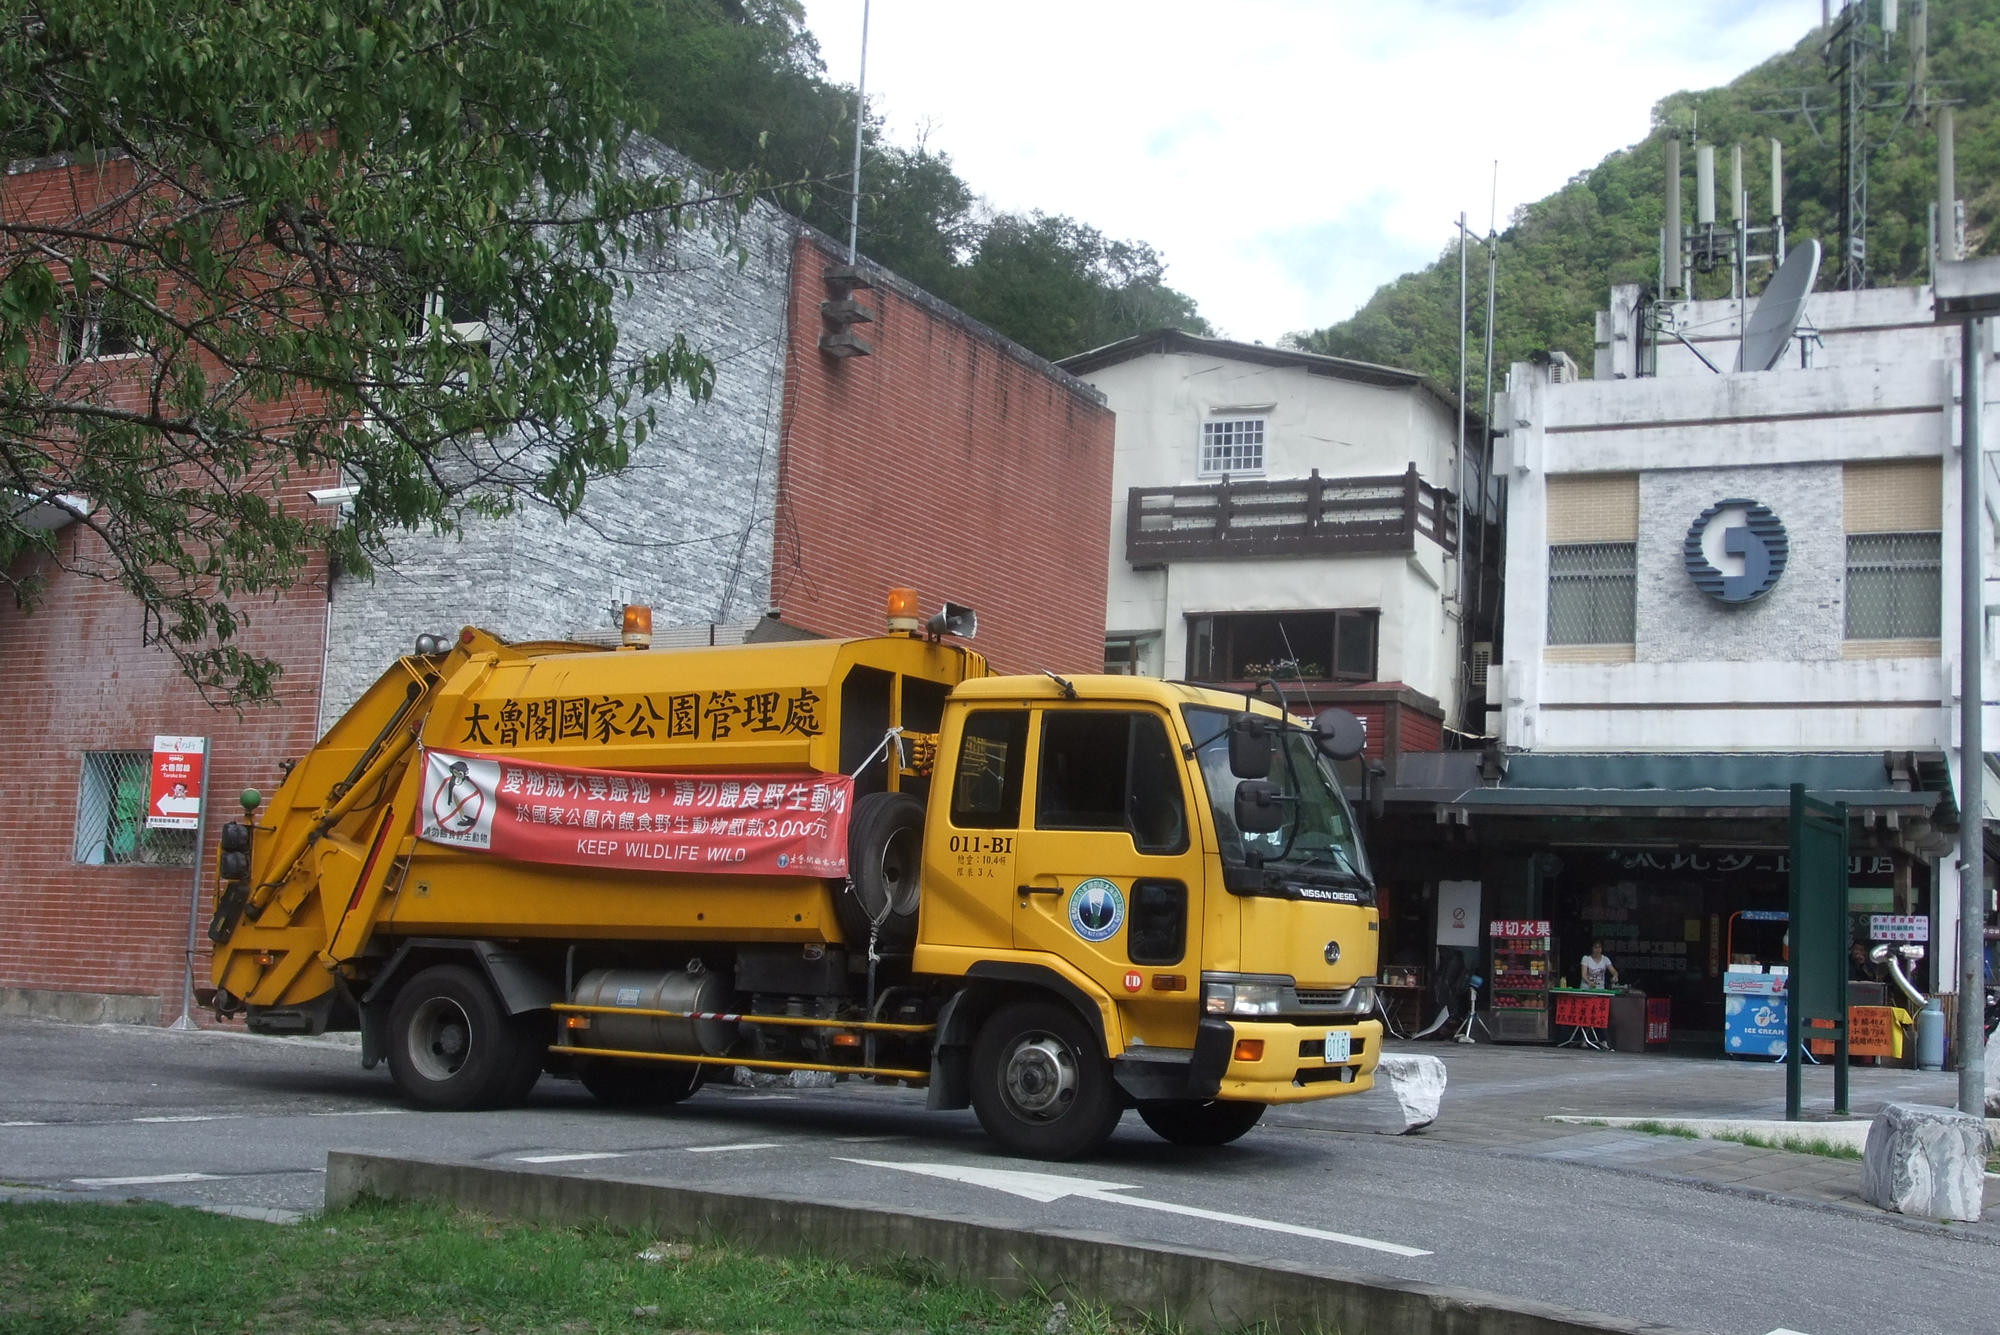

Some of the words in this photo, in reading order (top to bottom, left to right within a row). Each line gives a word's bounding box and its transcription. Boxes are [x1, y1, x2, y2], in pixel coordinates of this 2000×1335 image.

[460, 687, 824, 748] 太魯閣國家公園管理處
[577, 839, 618, 856] KEEP
[625, 841, 700, 861] WILDLIFE
[707, 847, 746, 862] WILD
[950, 835, 1013, 854] 011-BI
[1300, 888, 1331, 900] NISSAN
[1332, 892, 1358, 902] DIESEL
[1490, 921, 1551, 936] 鮮切水果
[1125, 975, 1141, 987] UD
[1757, 1028, 1785, 1036] CREAM
